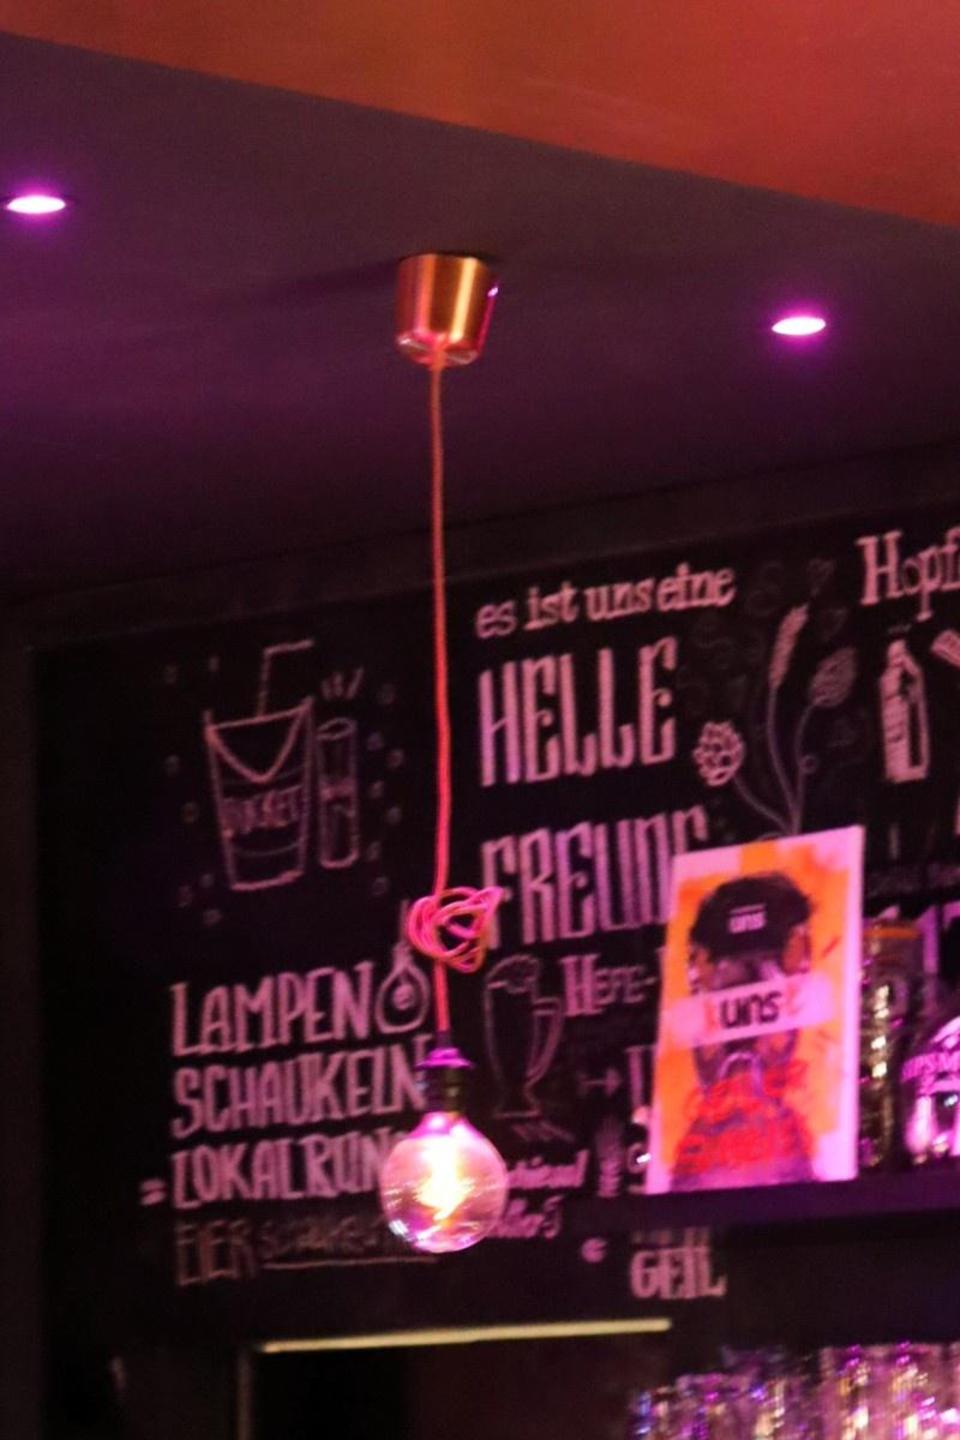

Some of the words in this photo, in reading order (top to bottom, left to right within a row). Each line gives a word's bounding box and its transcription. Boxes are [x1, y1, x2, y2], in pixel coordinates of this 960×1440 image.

[476, 600, 518, 639] es
[524, 583, 580, 631] ist
[585, 577, 651, 623] uns
[656, 562, 737, 612] eine
[478, 636, 678, 787] HELLE
[169, 958, 375, 1058] LAMPEN
[720, 991, 782, 1030] uns
[169, 1032, 434, 1140] SCHAUKELN
